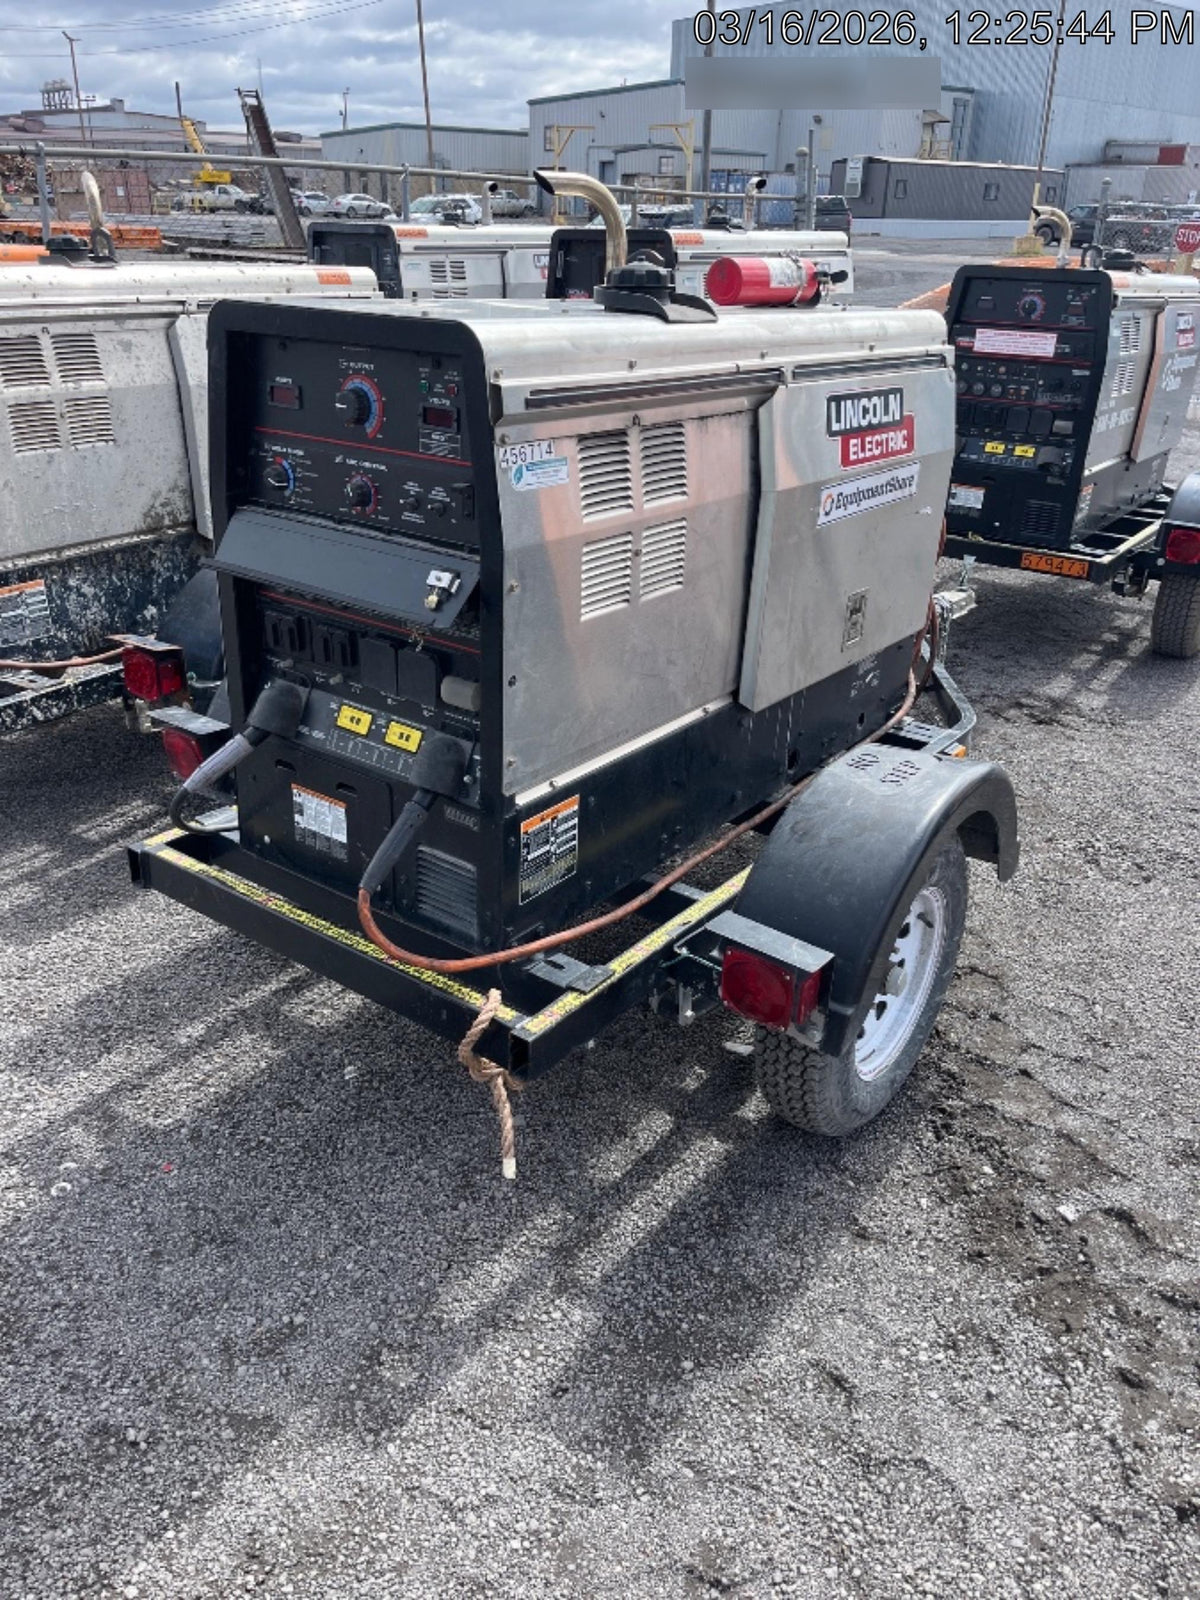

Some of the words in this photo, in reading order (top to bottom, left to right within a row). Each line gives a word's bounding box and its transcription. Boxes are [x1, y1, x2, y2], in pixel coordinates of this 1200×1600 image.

[831, 393, 900, 431] LINCOLN
[500, 440, 554, 465] 456714
[849, 429, 908, 461] ELECTRIC
[835, 474, 915, 511] EquipmentShare
